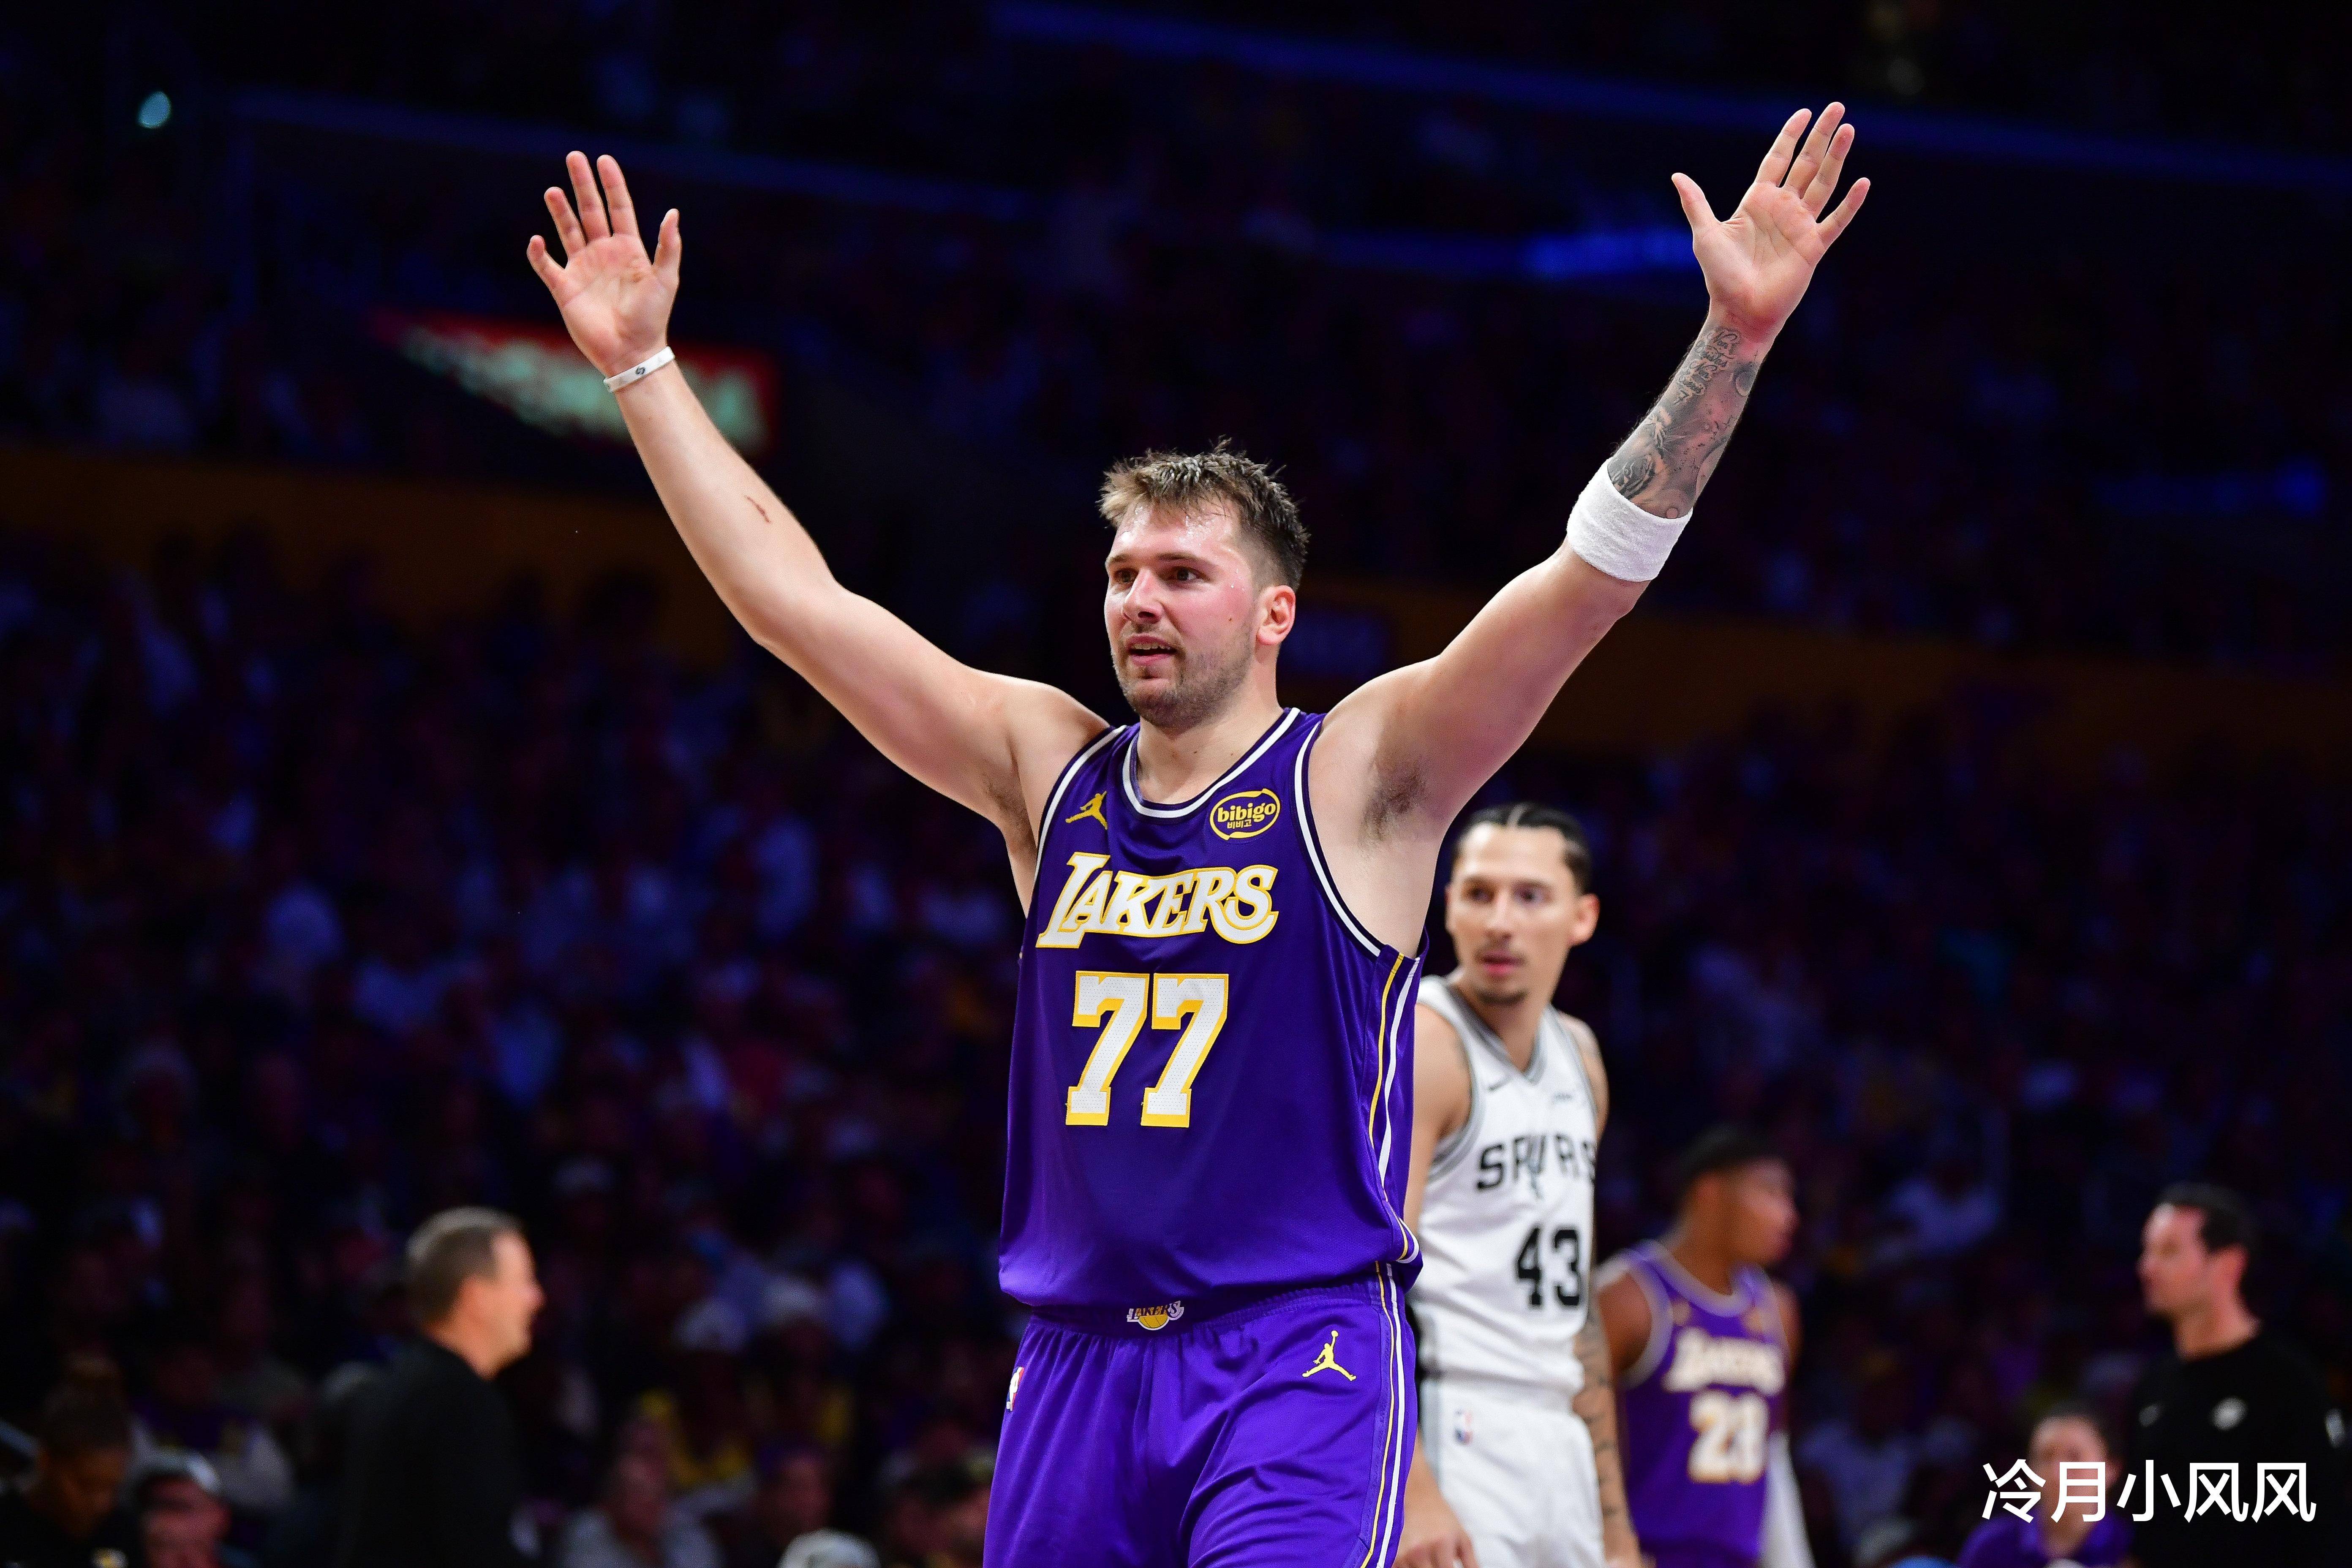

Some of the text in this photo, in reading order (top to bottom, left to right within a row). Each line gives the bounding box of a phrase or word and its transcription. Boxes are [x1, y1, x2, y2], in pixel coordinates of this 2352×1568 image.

[1217, 803, 1276, 822] bibigo
[1227, 819, 1252, 829] 비비고
[1035, 852, 1279, 949] LAKERS
[1065, 971, 1229, 1128] 77
[1516, 1227, 1581, 1307] 43
